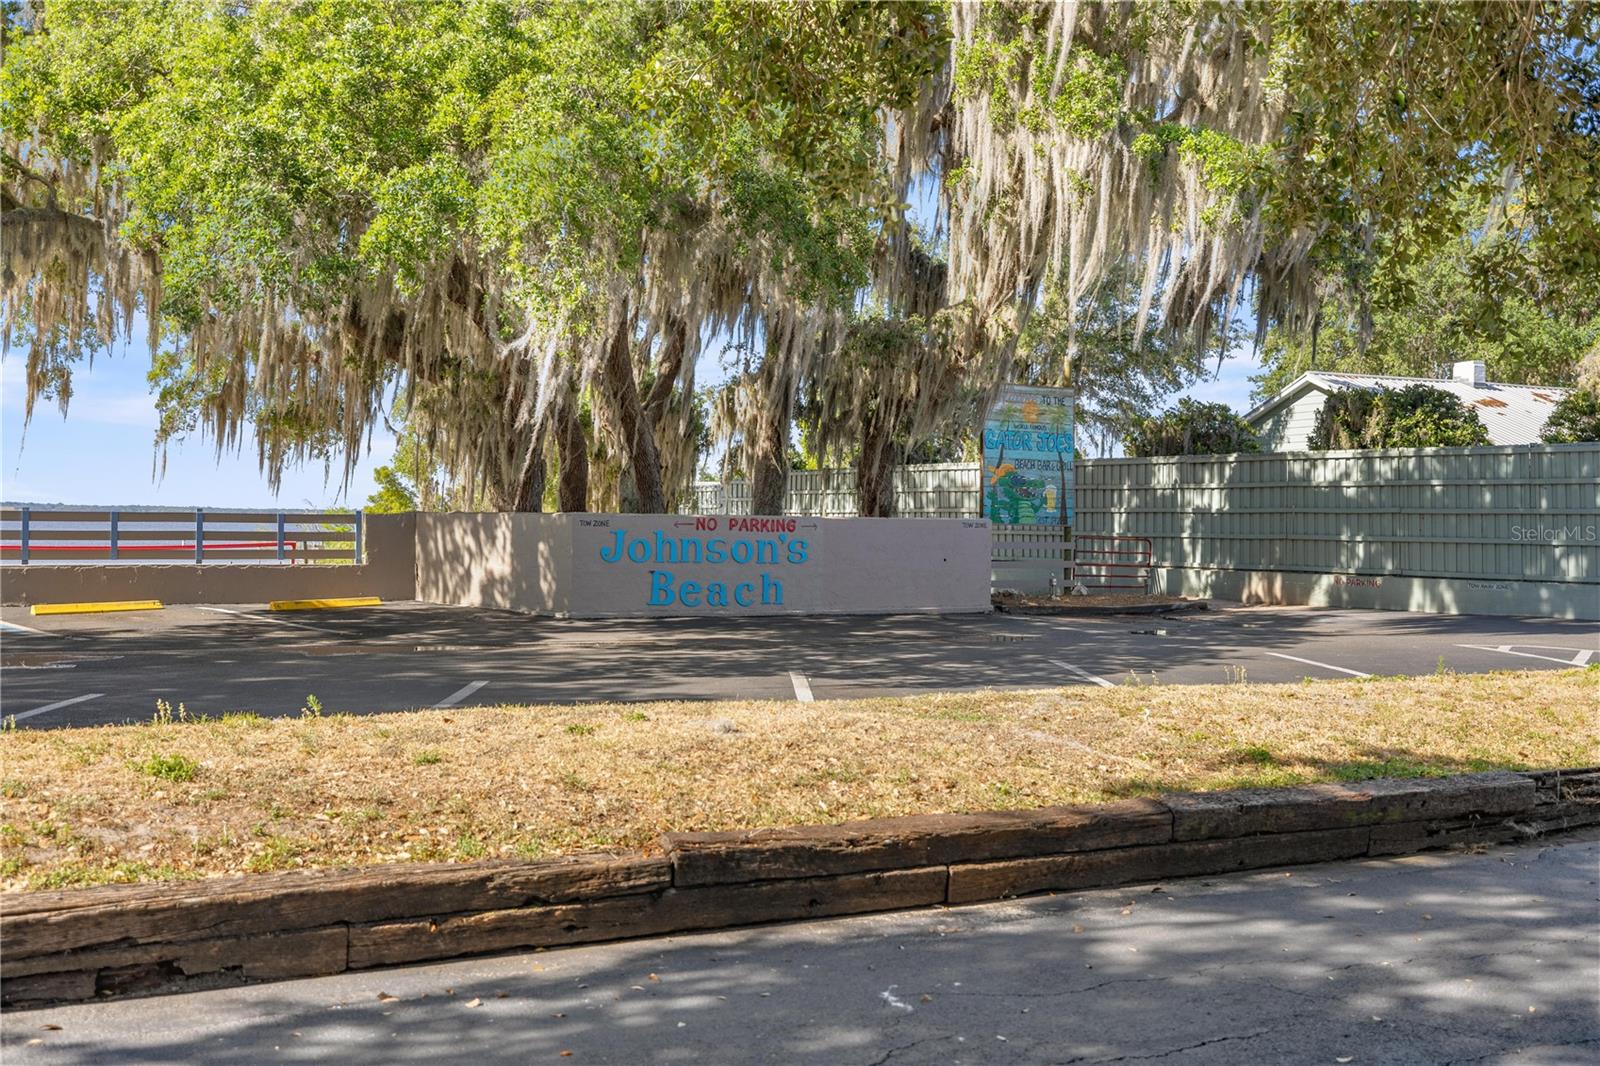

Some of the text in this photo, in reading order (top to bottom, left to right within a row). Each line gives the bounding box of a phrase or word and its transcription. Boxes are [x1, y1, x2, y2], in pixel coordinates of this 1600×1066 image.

[1042, 395, 1066, 407] TO THE
[985, 429, 1033, 451] GATOR
[1014, 458, 1036, 470] BEACH
[1037, 459, 1051, 471] BAR
[579, 519, 610, 528] TOW ZONE
[695, 517, 797, 533] NO PARKING
[600, 529, 809, 565] Johnson's
[646, 569, 784, 608] Beach
[1346, 577, 1382, 588] PARKING
